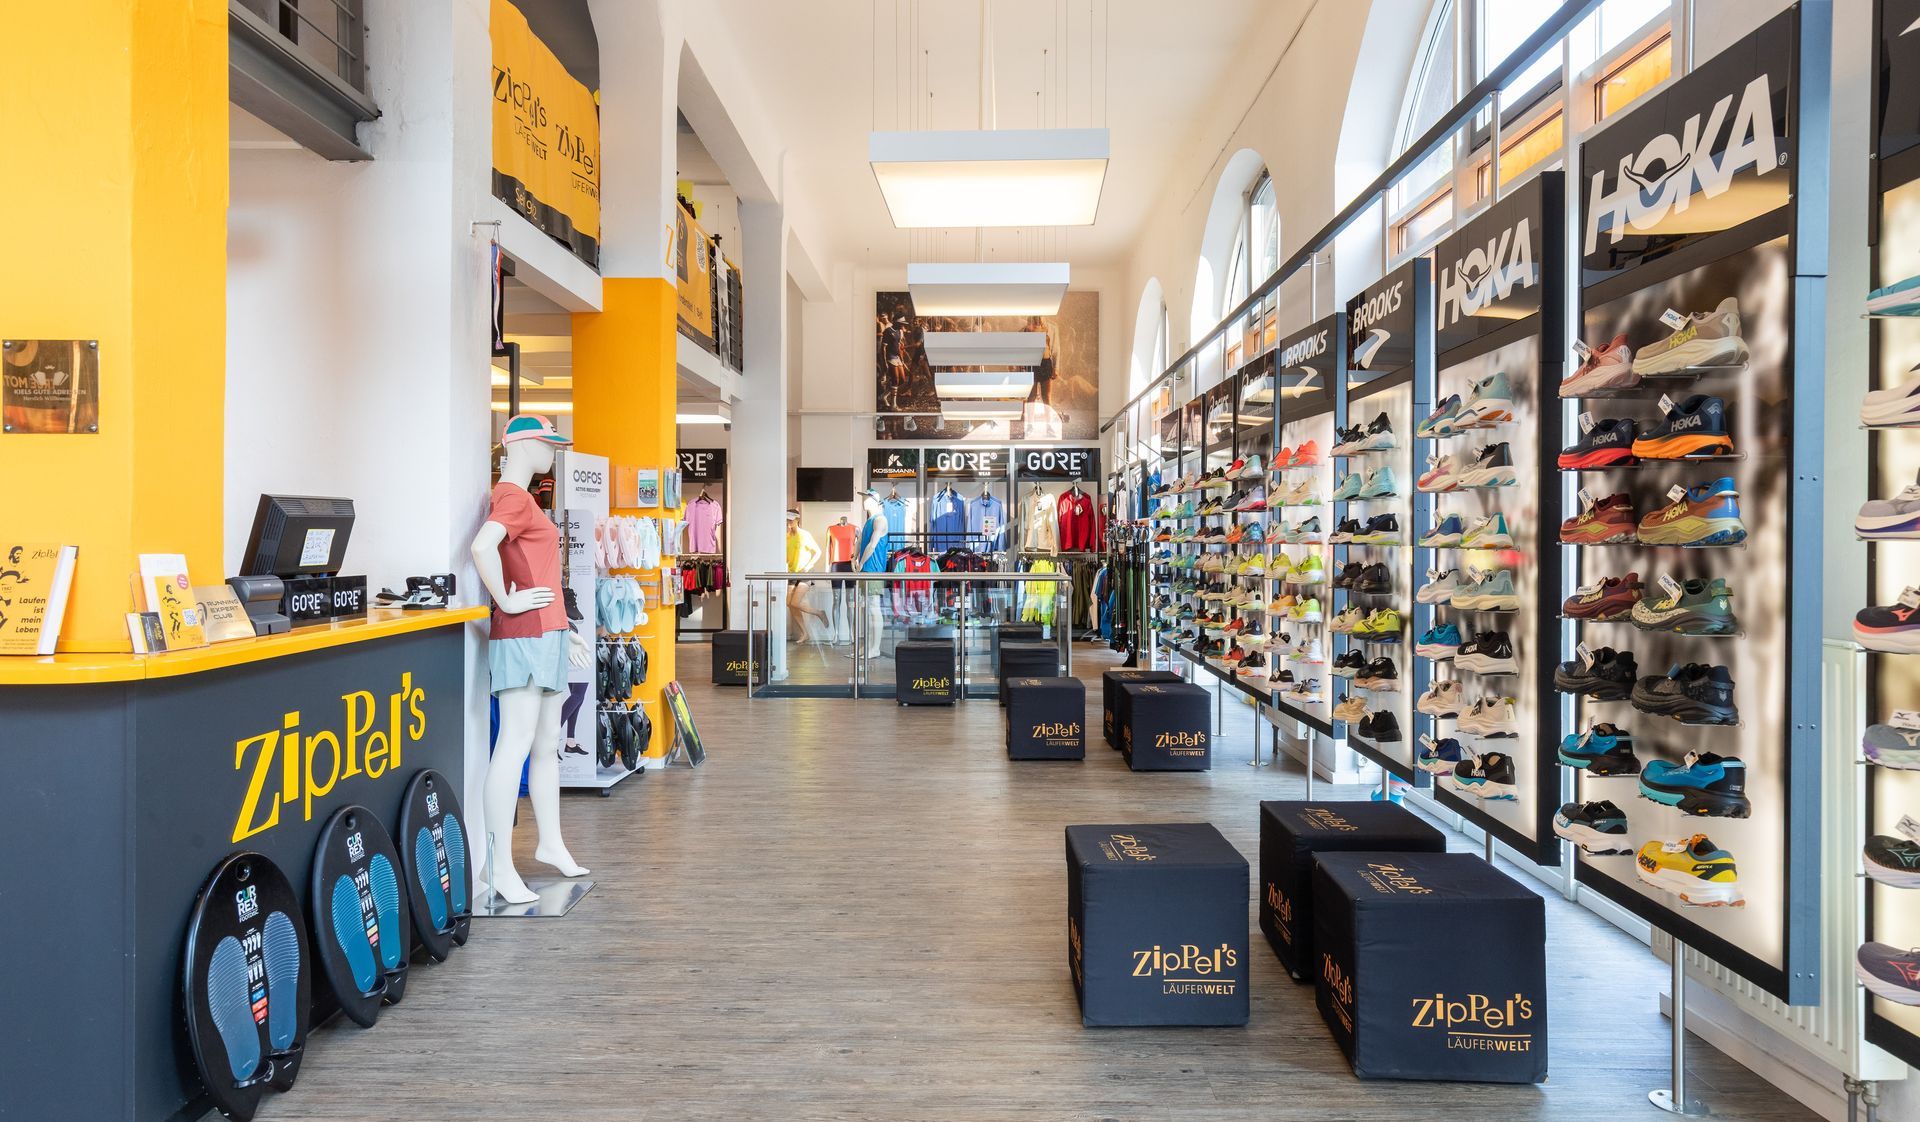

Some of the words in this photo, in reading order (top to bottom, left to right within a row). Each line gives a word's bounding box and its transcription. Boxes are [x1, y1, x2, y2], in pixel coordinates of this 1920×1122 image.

[1353, 280, 1403, 335] BROOKS
[1669, 325, 1698, 349] HOKA
[1286, 329, 1328, 368] BROOKS
[1671, 414, 1702, 433] HOKA
[1592, 431, 1618, 447] HOKA
[573, 470, 602, 485] OOFOS
[1663, 501, 1688, 521] HOKA
[19, 597, 46, 605] Laufen
[206, 598, 239, 606] RUNNING
[210, 605, 239, 613] EXPERT
[20, 616, 41, 624] mein
[213, 612, 233, 620] CLUB
[15, 626, 40, 634] Leben
[1465, 643, 1478, 654] HOKA
[1032, 722, 1081, 739] ZipPel's
[1155, 730, 1206, 749] ZipPel's
[231, 671, 426, 844] ZipPel's
[346, 831, 362, 848] CUR
[348, 843, 365, 859] REX
[235, 884, 257, 904] CUR
[237, 894, 258, 916] REX
[1132, 942, 1238, 978] ZipPel's
[1163, 984, 1236, 996] LÄUFERWELT
[1411, 992, 1533, 1029] ZipPel's
[1447, 1035, 1532, 1052] LÄUFERWELT
